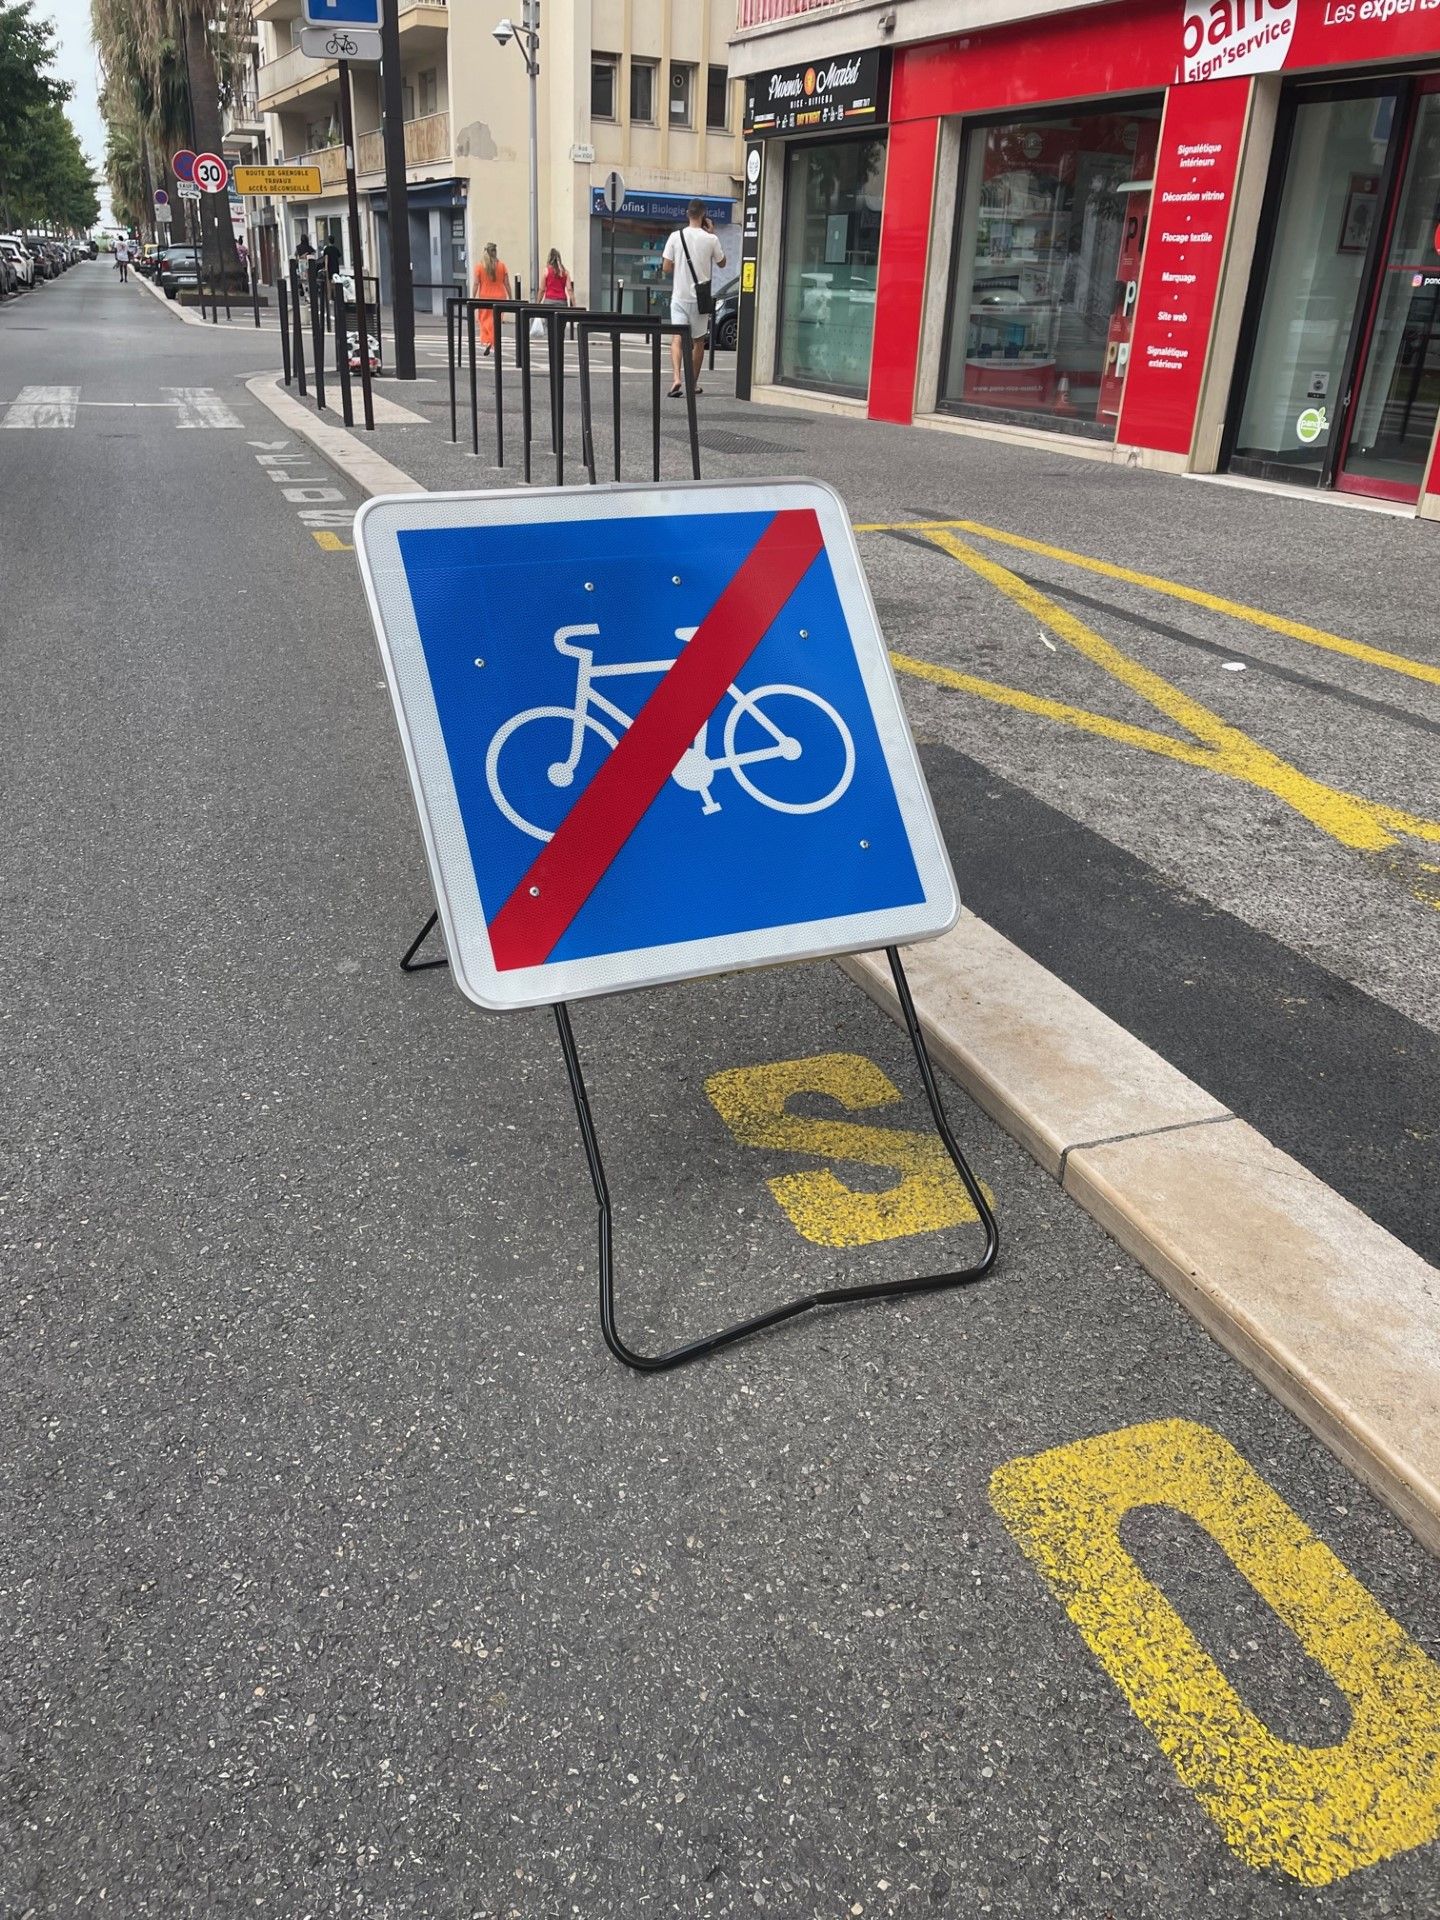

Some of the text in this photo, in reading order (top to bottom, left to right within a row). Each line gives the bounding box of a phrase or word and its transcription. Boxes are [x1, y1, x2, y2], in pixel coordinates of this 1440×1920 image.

[1324, 2, 1356, 26] Les
[1180, 0, 1291, 76] pan
[1188, 18, 1291, 81] sign'service
[768, 57, 861, 101] Phoenix Market
[1178, 143, 1222, 156] Signalétique
[1179, 156, 1215, 168] intérieure
[200, 165, 220, 182] 30
[1162, 190, 1225, 203] Décoration vitrine
[622, 202, 645, 213] ofins
[651, 205, 685, 217] Biologie
[1162, 232, 1213, 244] Flocage textile
[1161, 271, 1197, 284] Marquage
[1157, 311, 1188, 322] Site web
[1147, 345, 1189, 358] Signalétique
[1148, 358, 1183, 370] extérieure
